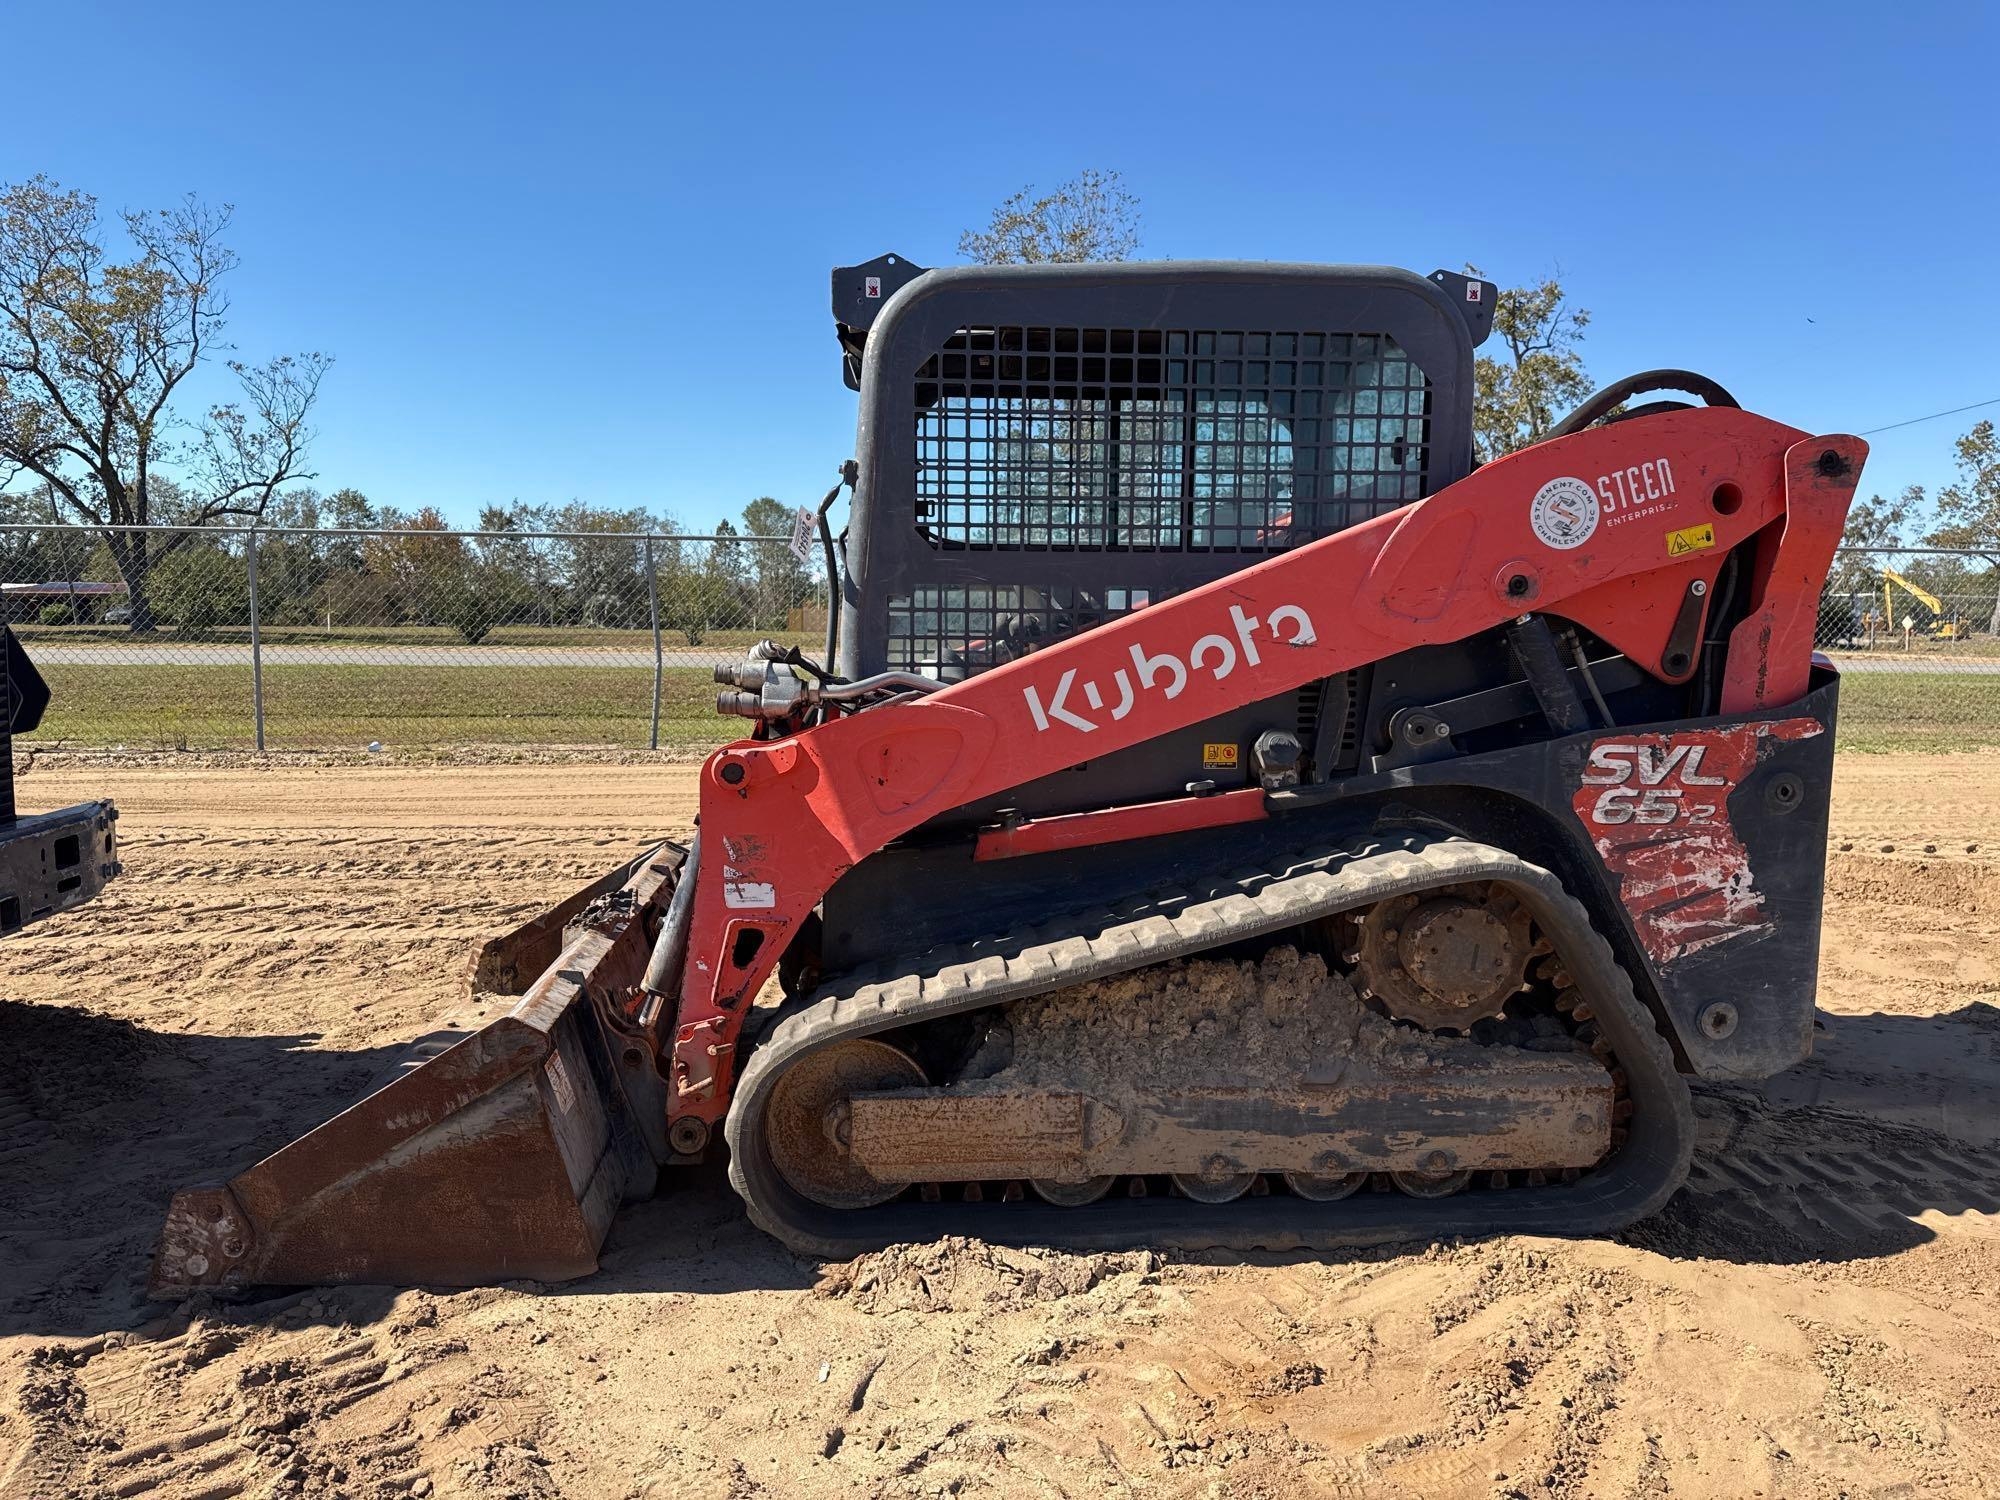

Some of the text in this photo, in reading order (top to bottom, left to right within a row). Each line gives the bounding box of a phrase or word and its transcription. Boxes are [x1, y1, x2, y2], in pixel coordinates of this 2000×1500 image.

[1597, 458, 1676, 513] STEEN
[1606, 503, 1679, 527] ENTERPRIS
[1022, 604, 1318, 733] Kubota
[1581, 745, 1725, 786] SVL
